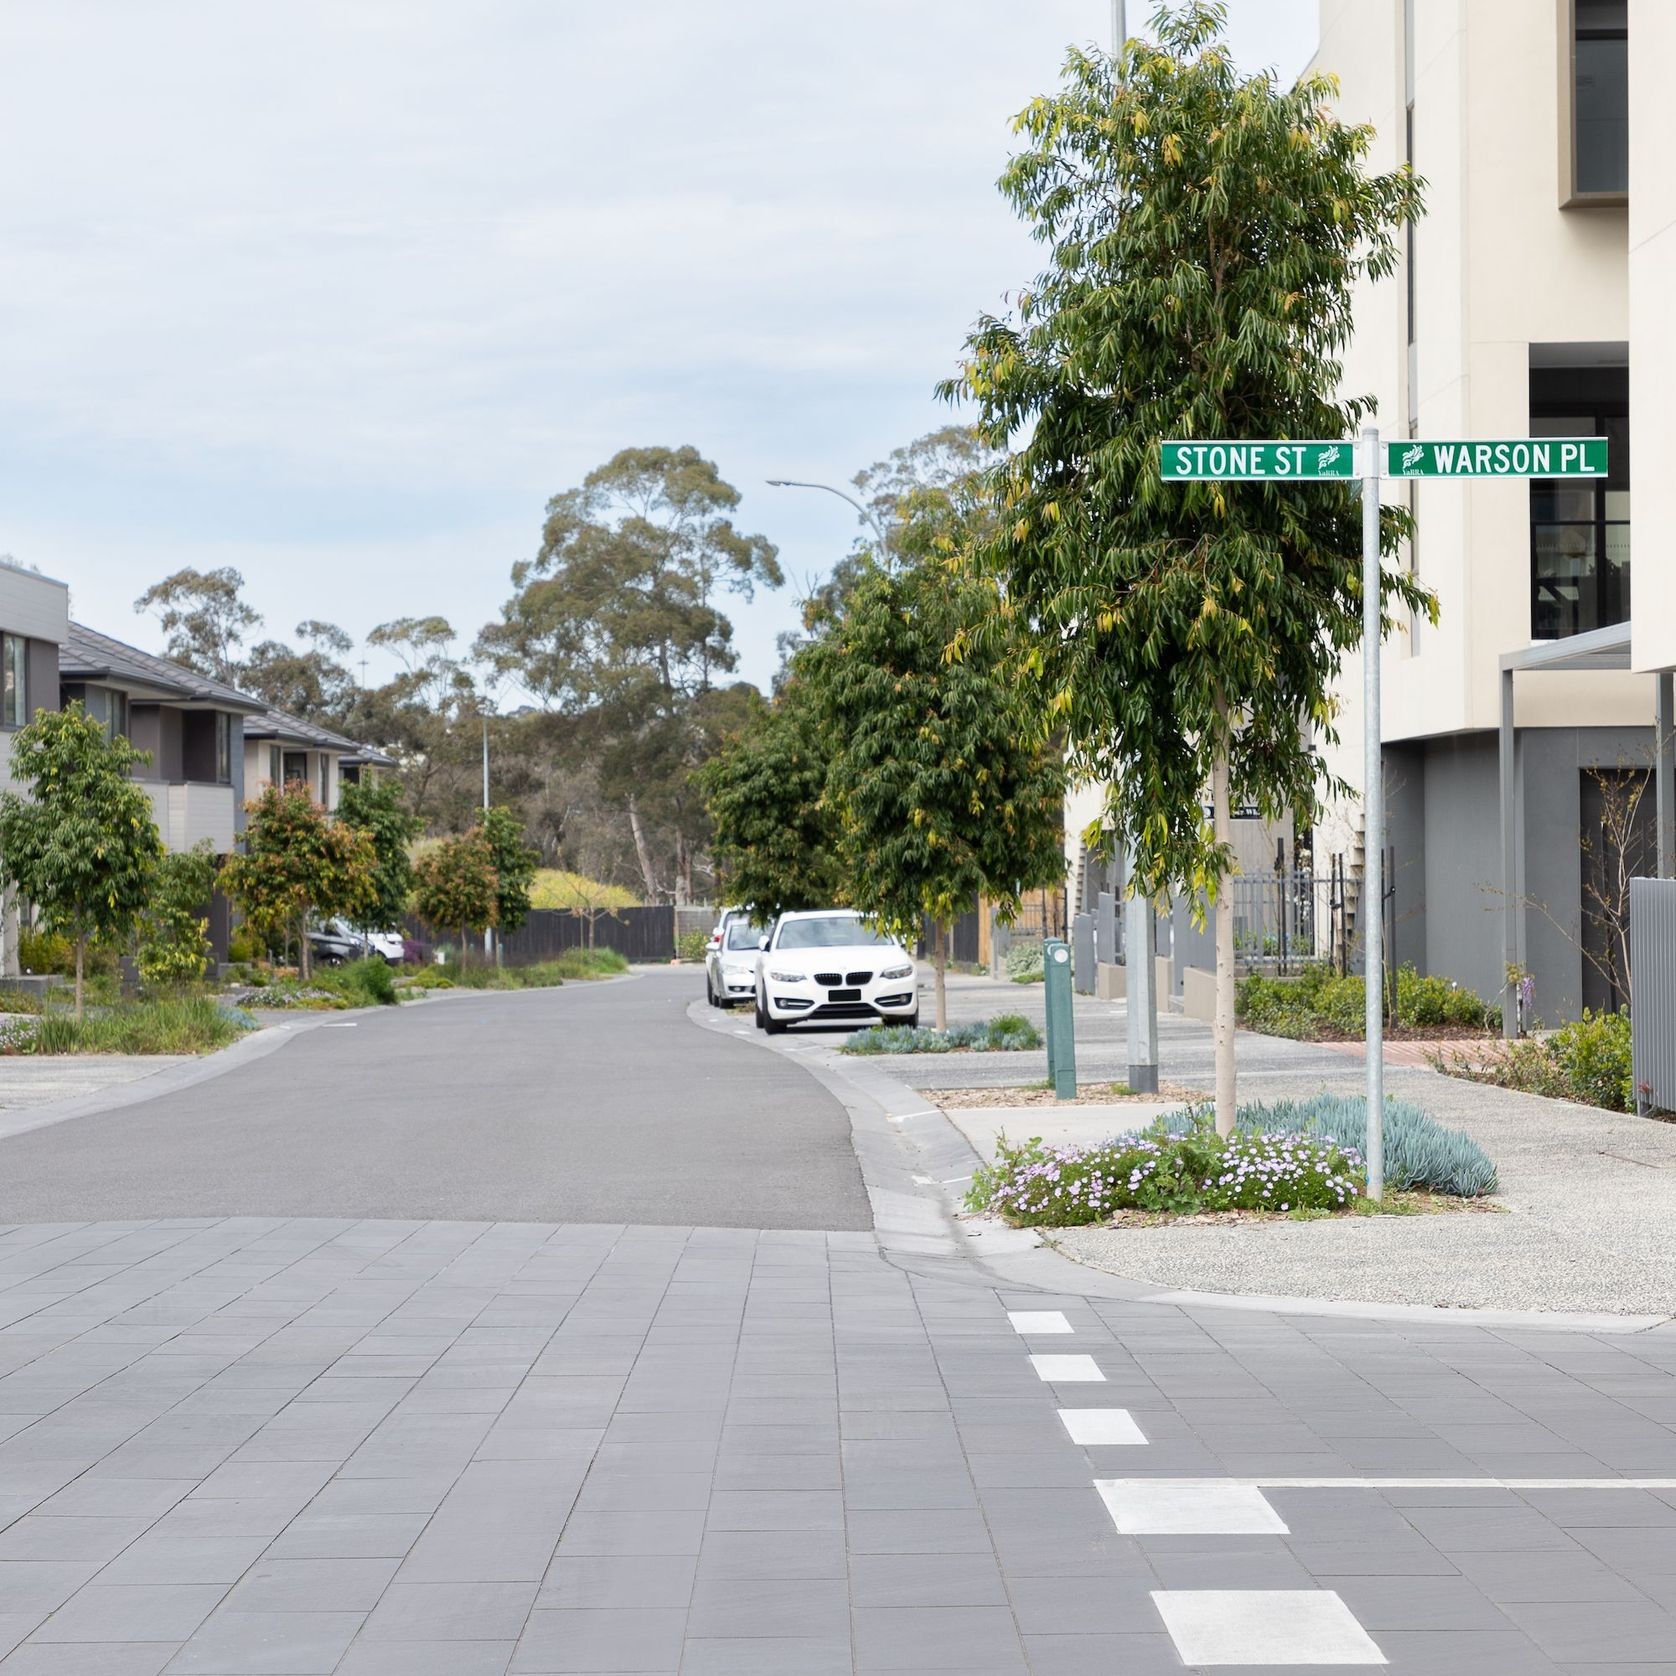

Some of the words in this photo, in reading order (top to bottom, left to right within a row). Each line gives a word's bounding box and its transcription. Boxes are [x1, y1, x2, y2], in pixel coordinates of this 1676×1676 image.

[1175, 446, 1266, 475] STONE
[1274, 446, 1307, 475] ST
[1433, 445, 1550, 473] WARSON
[1561, 444, 1595, 472] PL
